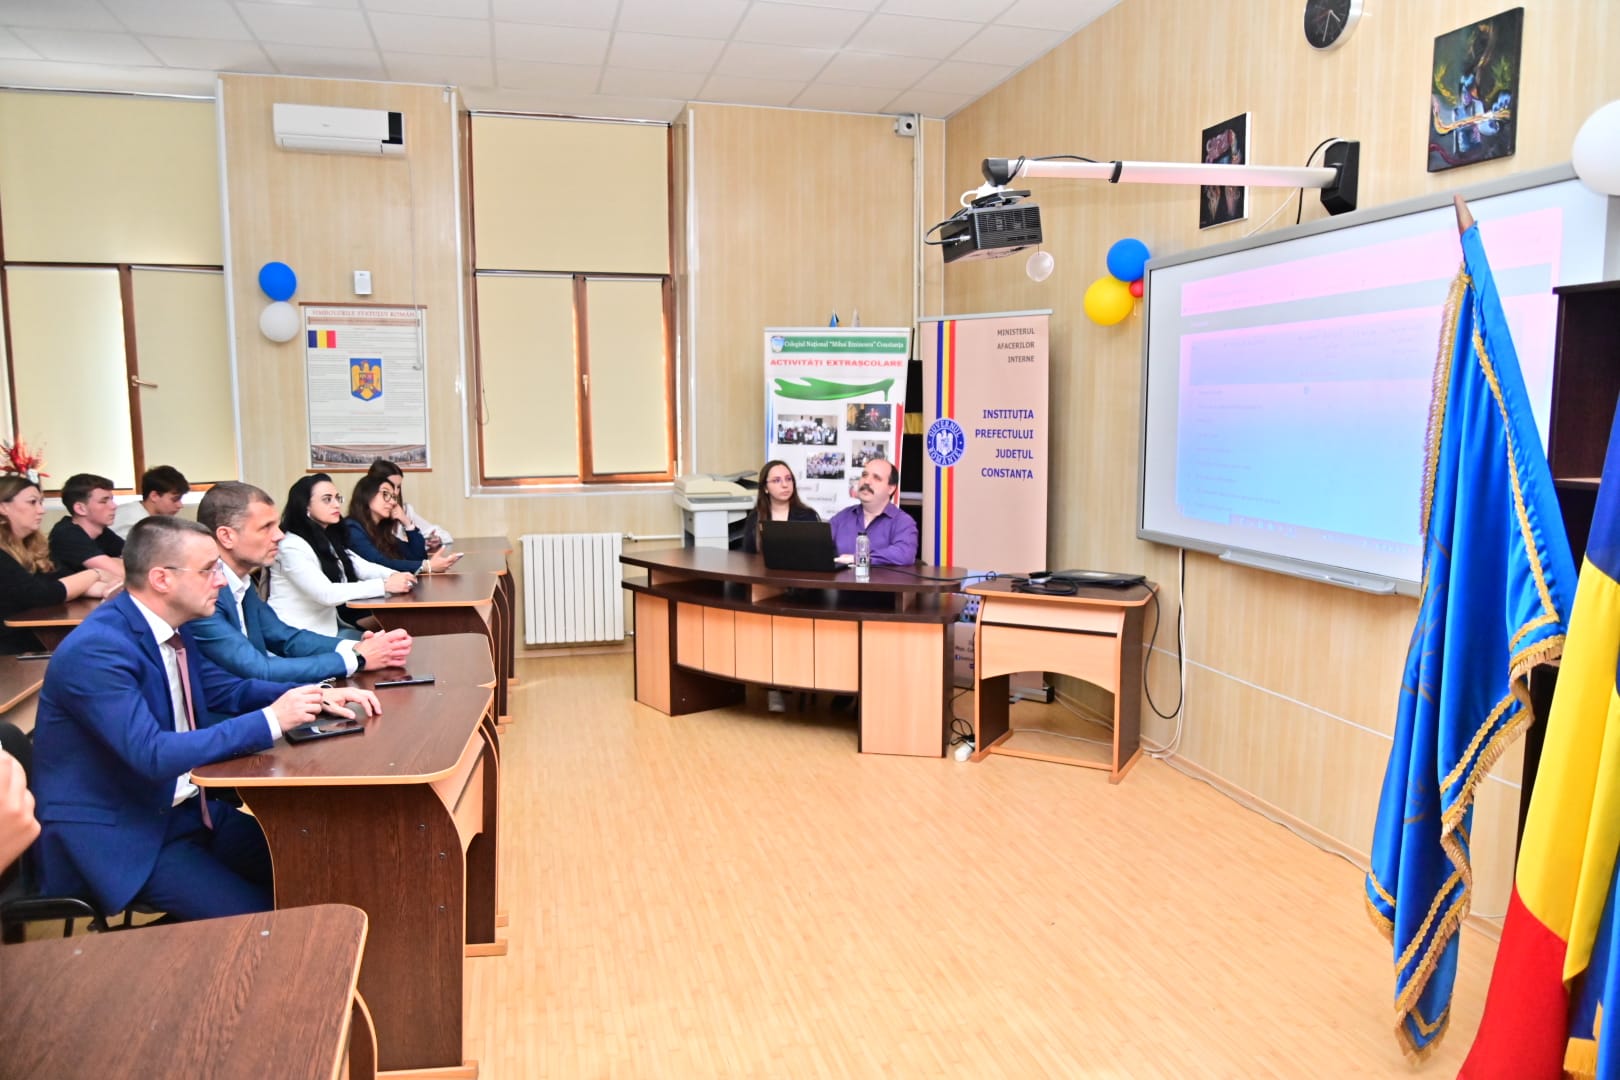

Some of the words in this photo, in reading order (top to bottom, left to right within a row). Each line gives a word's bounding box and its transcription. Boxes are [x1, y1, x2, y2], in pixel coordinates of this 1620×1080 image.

[997, 328, 1035, 336] MINISTERUL
[997, 341, 1035, 350] AFACERILOR
[1007, 355, 1035, 363] INTERNE
[983, 409, 1034, 421] INSTITUȚIA
[975, 429, 1034, 439] PREFECTULUI
[995, 449, 1034, 461] JUDEȚUL
[981, 467, 1034, 481] CONSTANȚA
